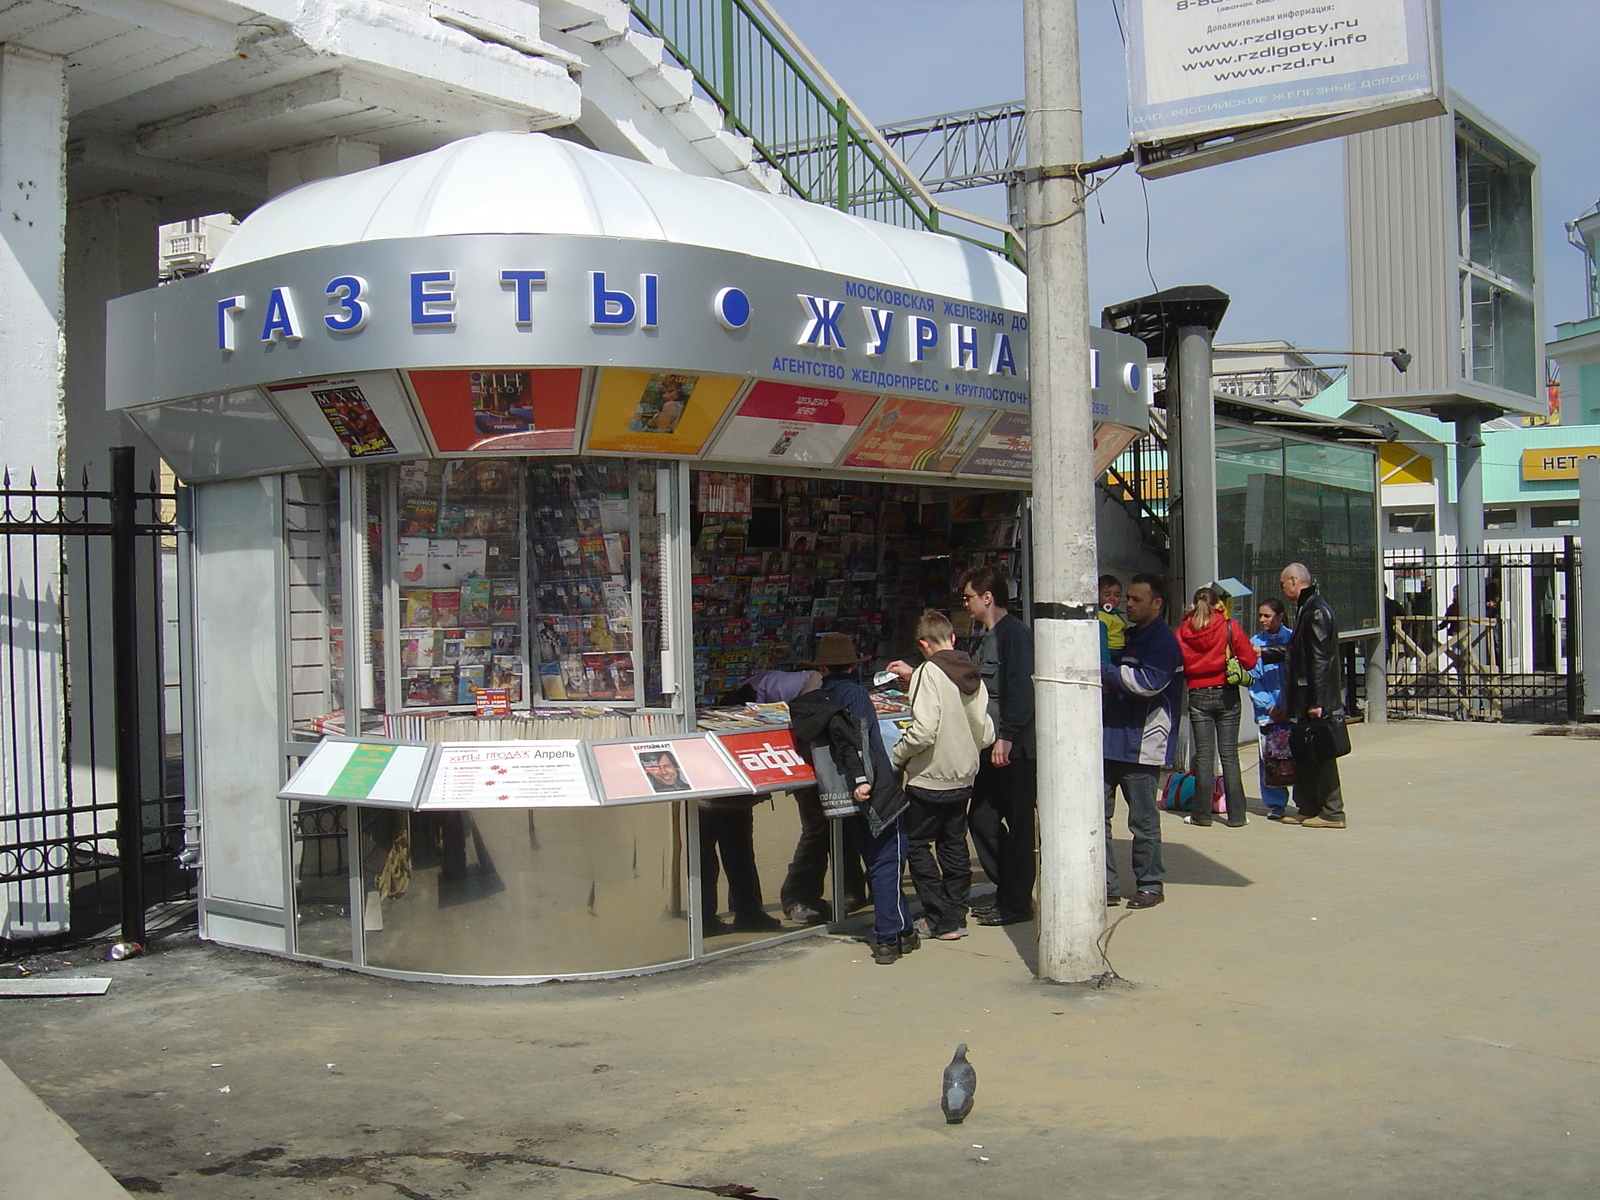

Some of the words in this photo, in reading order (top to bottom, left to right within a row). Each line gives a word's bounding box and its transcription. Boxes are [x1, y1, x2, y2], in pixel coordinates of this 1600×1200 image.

[1187, 18, 1359, 55] www.rzdlgoty.ru
[1206, 14, 1275, 34] Дополнительная
[1277, 4, 1335, 21] информация:
[1182, 33, 1367, 72] www.rzdlgoty.info
[1214, 55, 1335, 82] www.rzd.ru
[1133, 113, 1162, 124] ОАО
[1272, 82, 1356, 101] ЖЕЛЕЗНЫЕ
[217, 269, 659, 352] ГАЗЕТЫ
[845, 281, 934, 312] МОСКОВСКАЯ
[943, 303, 1004, 326] ЖЕЛЕЗНАЯ
[1011, 314, 1028, 331] ДО
[797, 293, 1099, 390] ЖУРНА
[772, 357, 845, 380] АГЕНТСТВО
[851, 368, 939, 392] ЖЕЛДОРПРЕСС
[1091, 402, 1109, 416] 2836
[1543, 456, 1578, 470] НЕТ
[486, 750, 531, 760] ПРОДАЖ
[534, 749, 575, 760] Апрель
